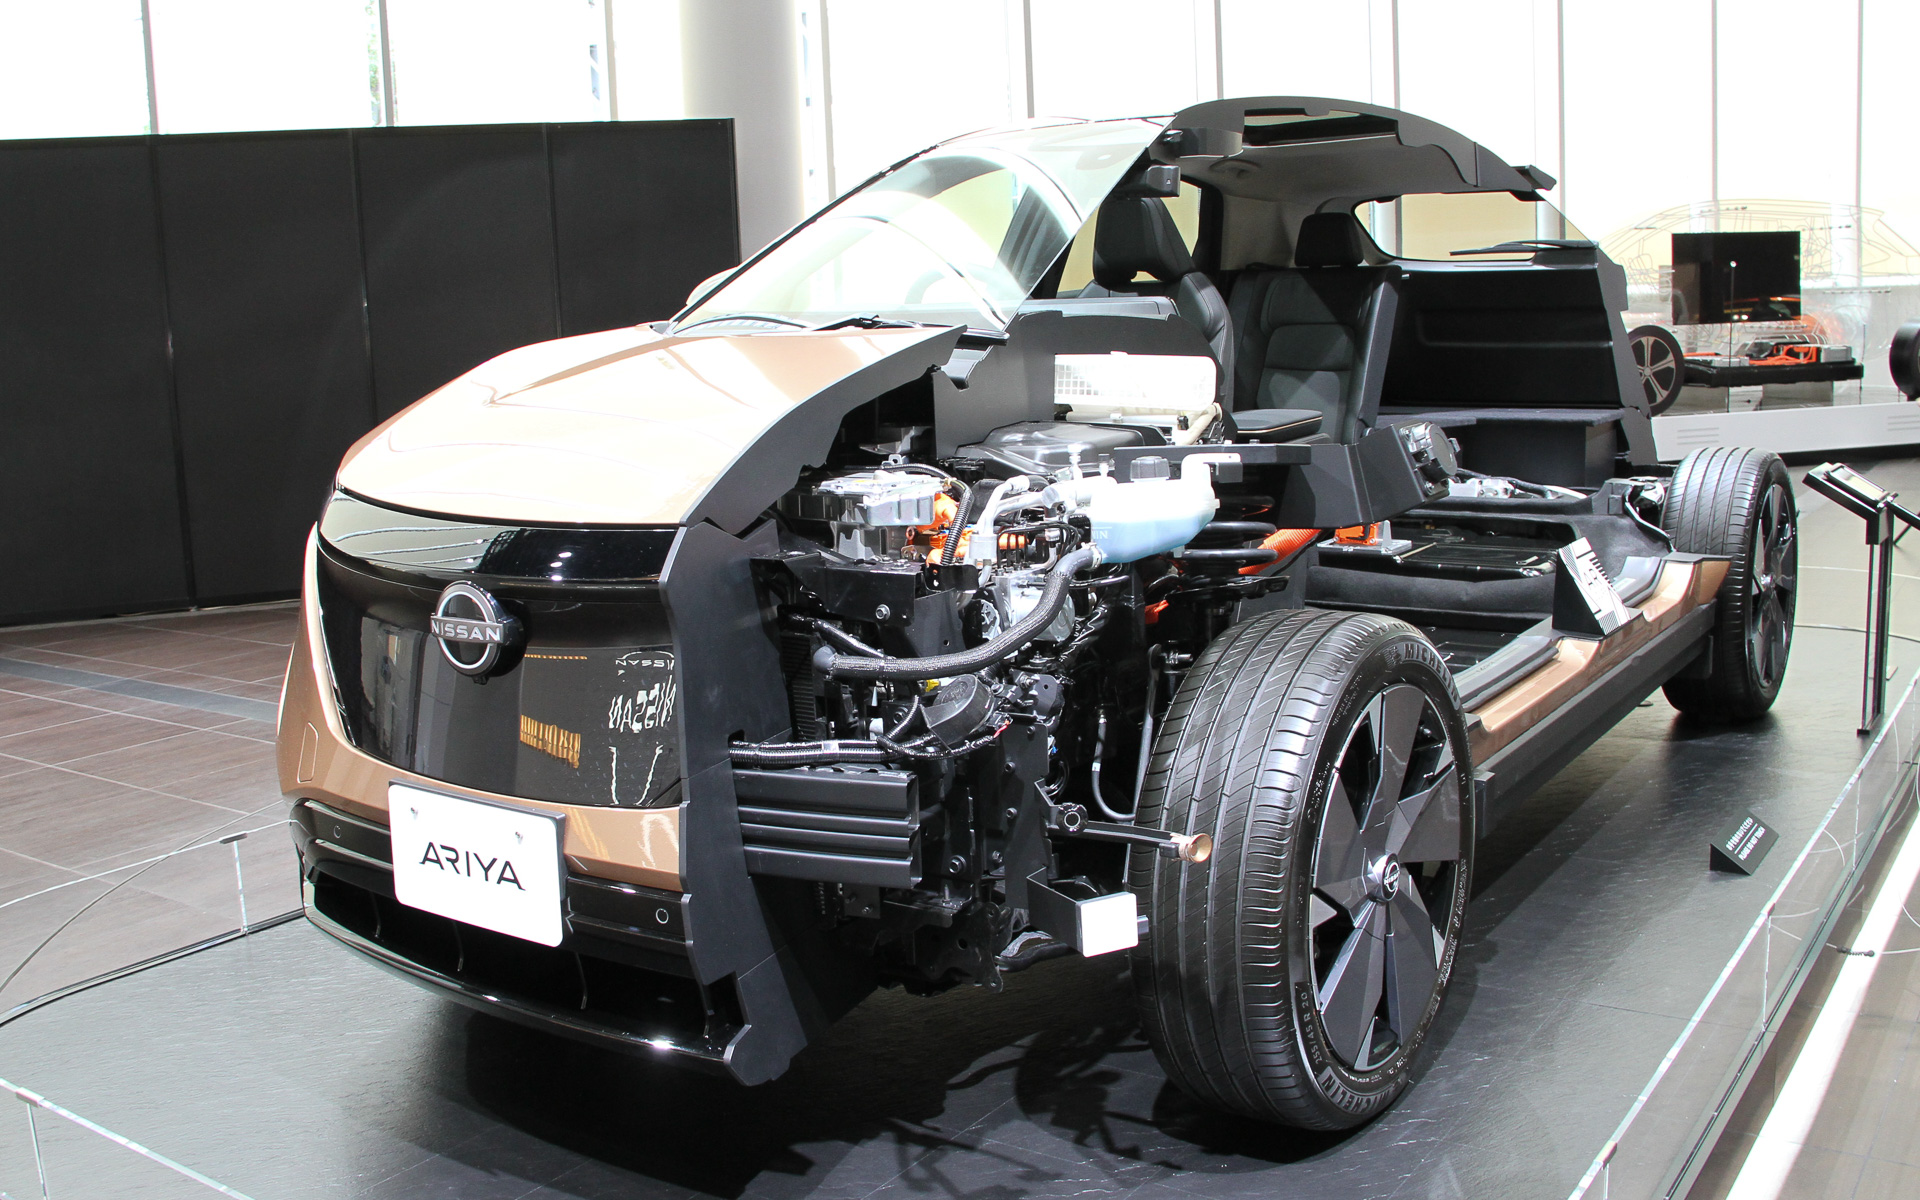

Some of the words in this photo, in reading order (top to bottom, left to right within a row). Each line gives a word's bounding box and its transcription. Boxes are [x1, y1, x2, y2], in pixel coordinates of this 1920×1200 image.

[431, 620, 501, 641] NISSAN
[1403, 643, 1458, 702] MICHELIN
[419, 841, 526, 891] ARIYA
